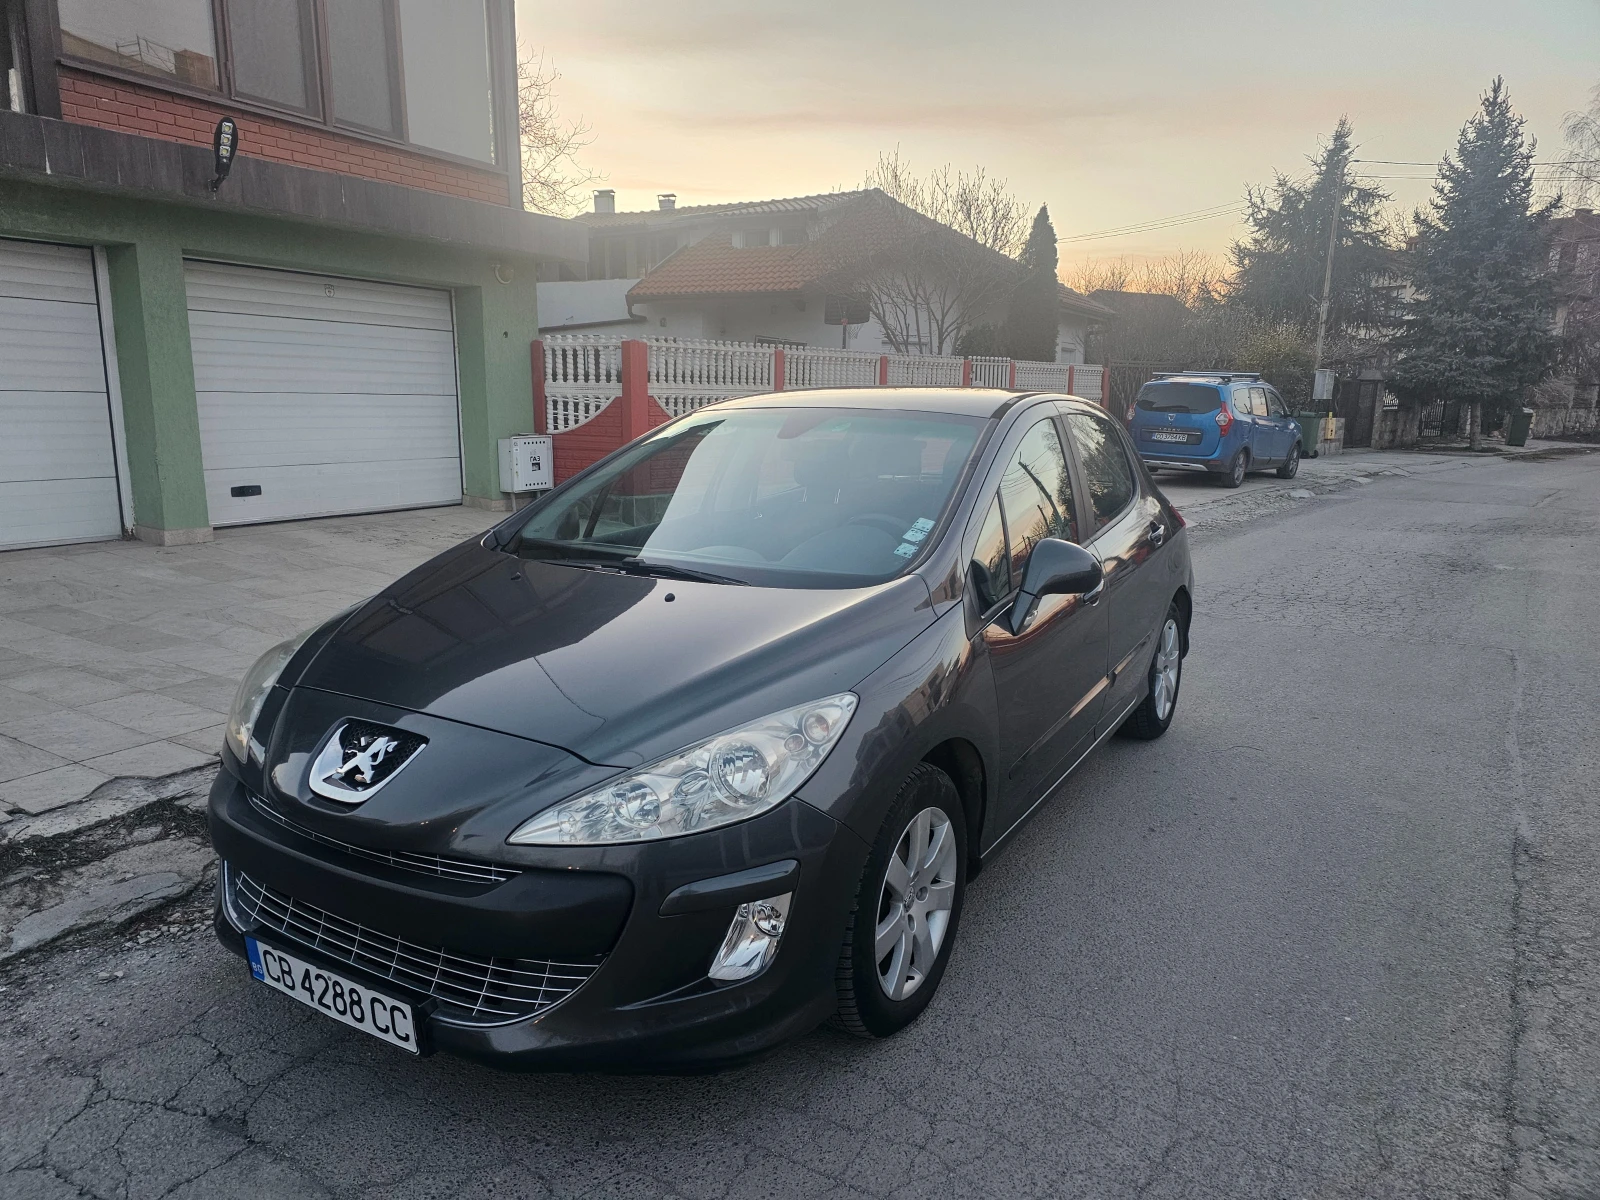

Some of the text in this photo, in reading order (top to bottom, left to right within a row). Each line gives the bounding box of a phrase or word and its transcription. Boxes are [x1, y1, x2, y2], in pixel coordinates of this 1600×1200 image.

[251, 961, 263, 975] BG
[263, 949, 410, 1043] CB 4288 CC
